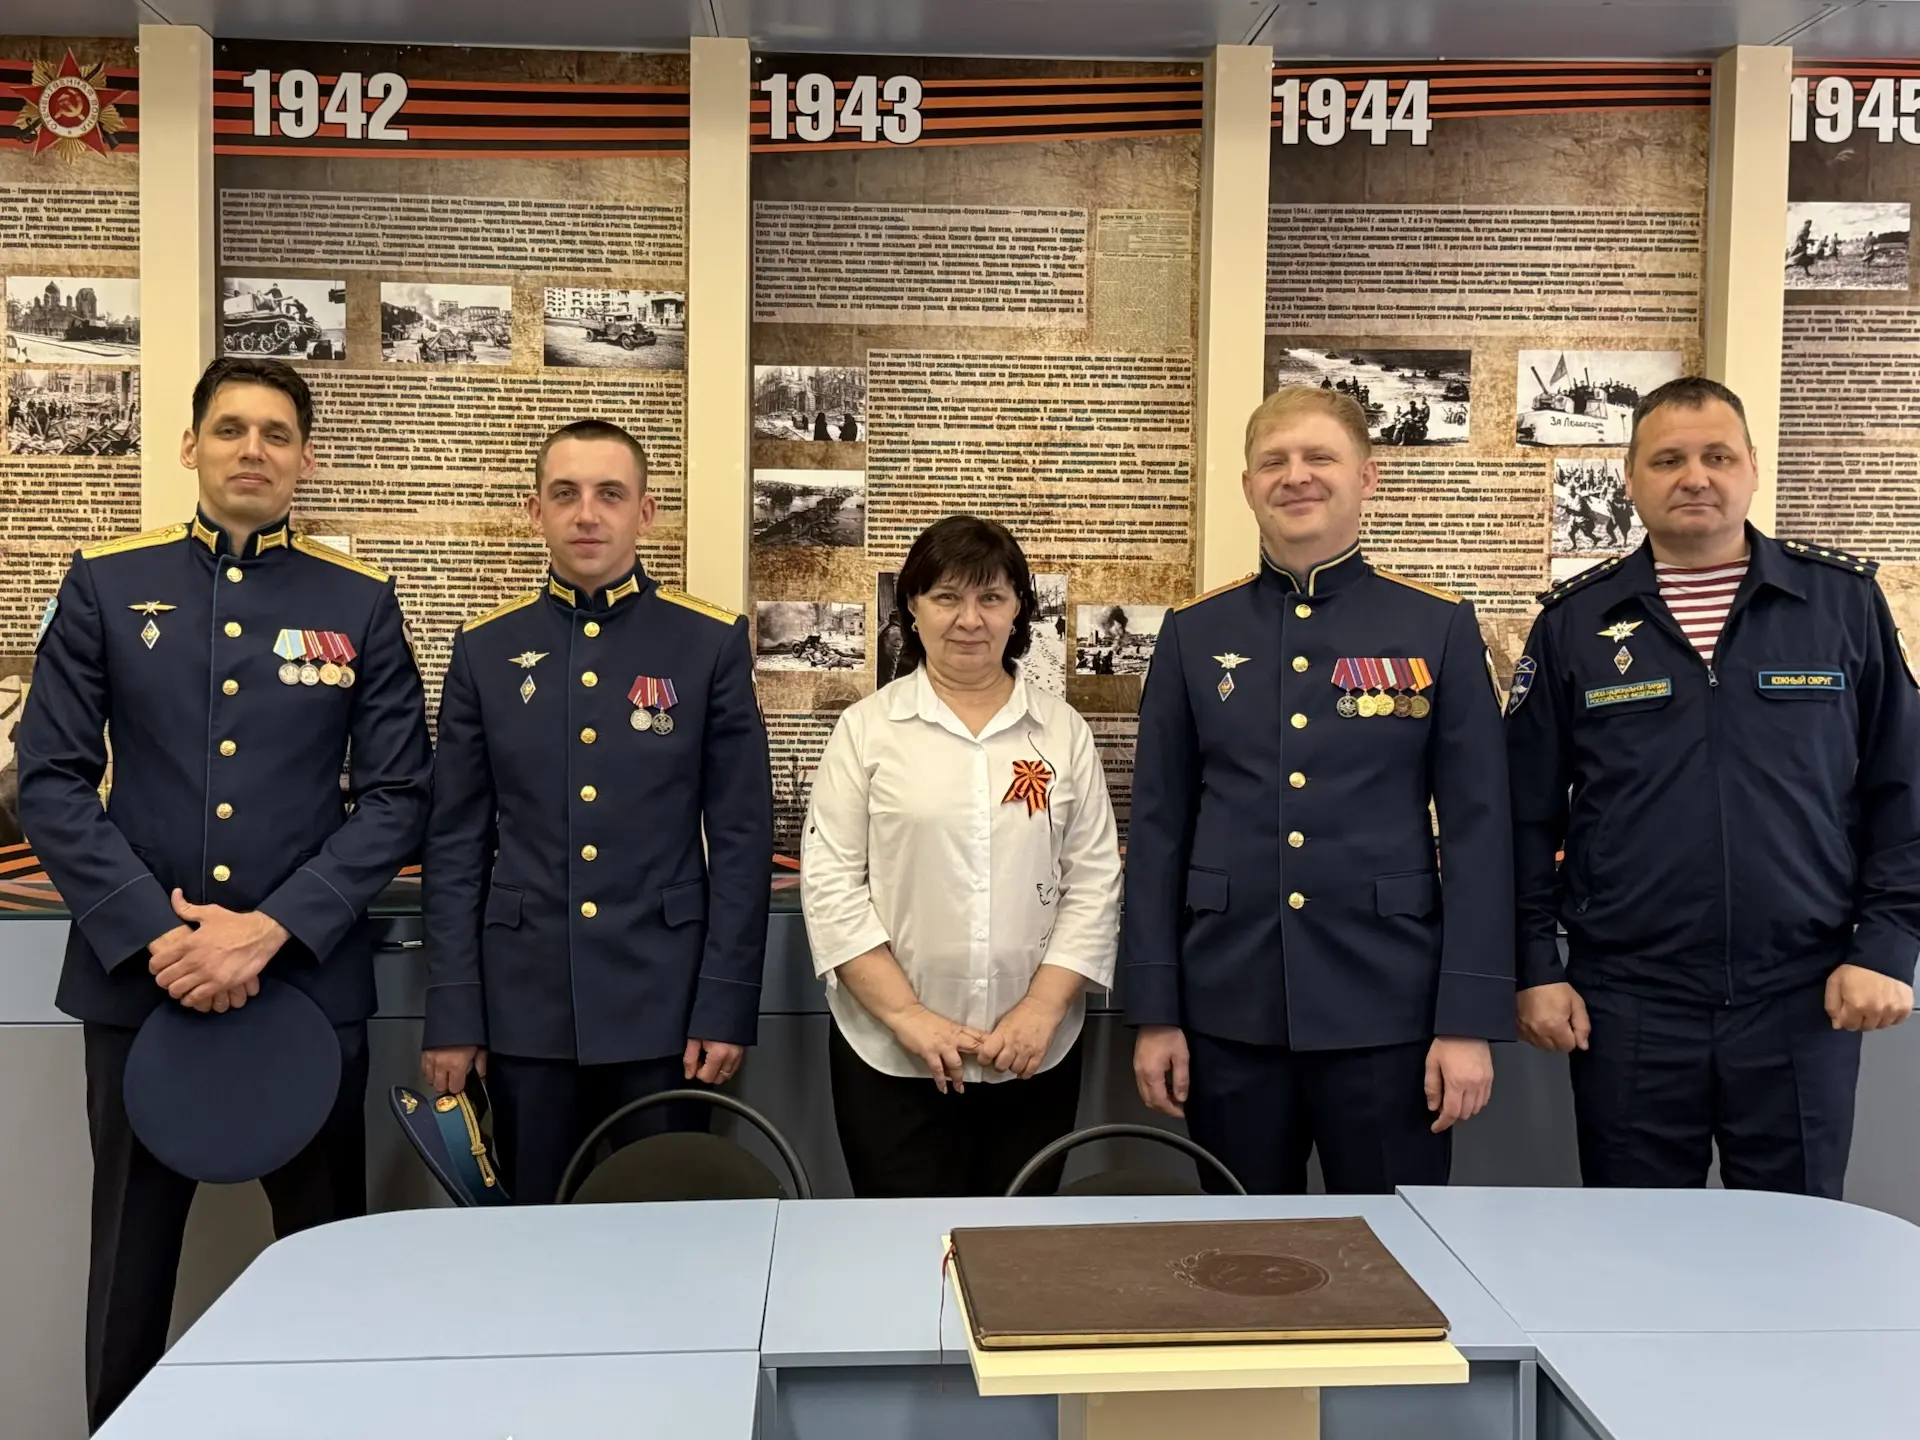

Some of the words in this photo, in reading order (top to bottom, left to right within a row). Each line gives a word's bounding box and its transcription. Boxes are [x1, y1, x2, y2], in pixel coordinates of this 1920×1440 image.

[41, 78, 94, 130] ОТЕЧЕСТВЕННАЯ
[80, 99, 98, 131] ВОЙНА
[243, 69, 408, 141] 1942
[761, 73, 922, 144] 1943
[1274, 78, 1432, 146] 1944
[1771, 675, 1806, 685] ЮЖНЫЙ
[1807, 676, 1833, 686] ОКРУГ
